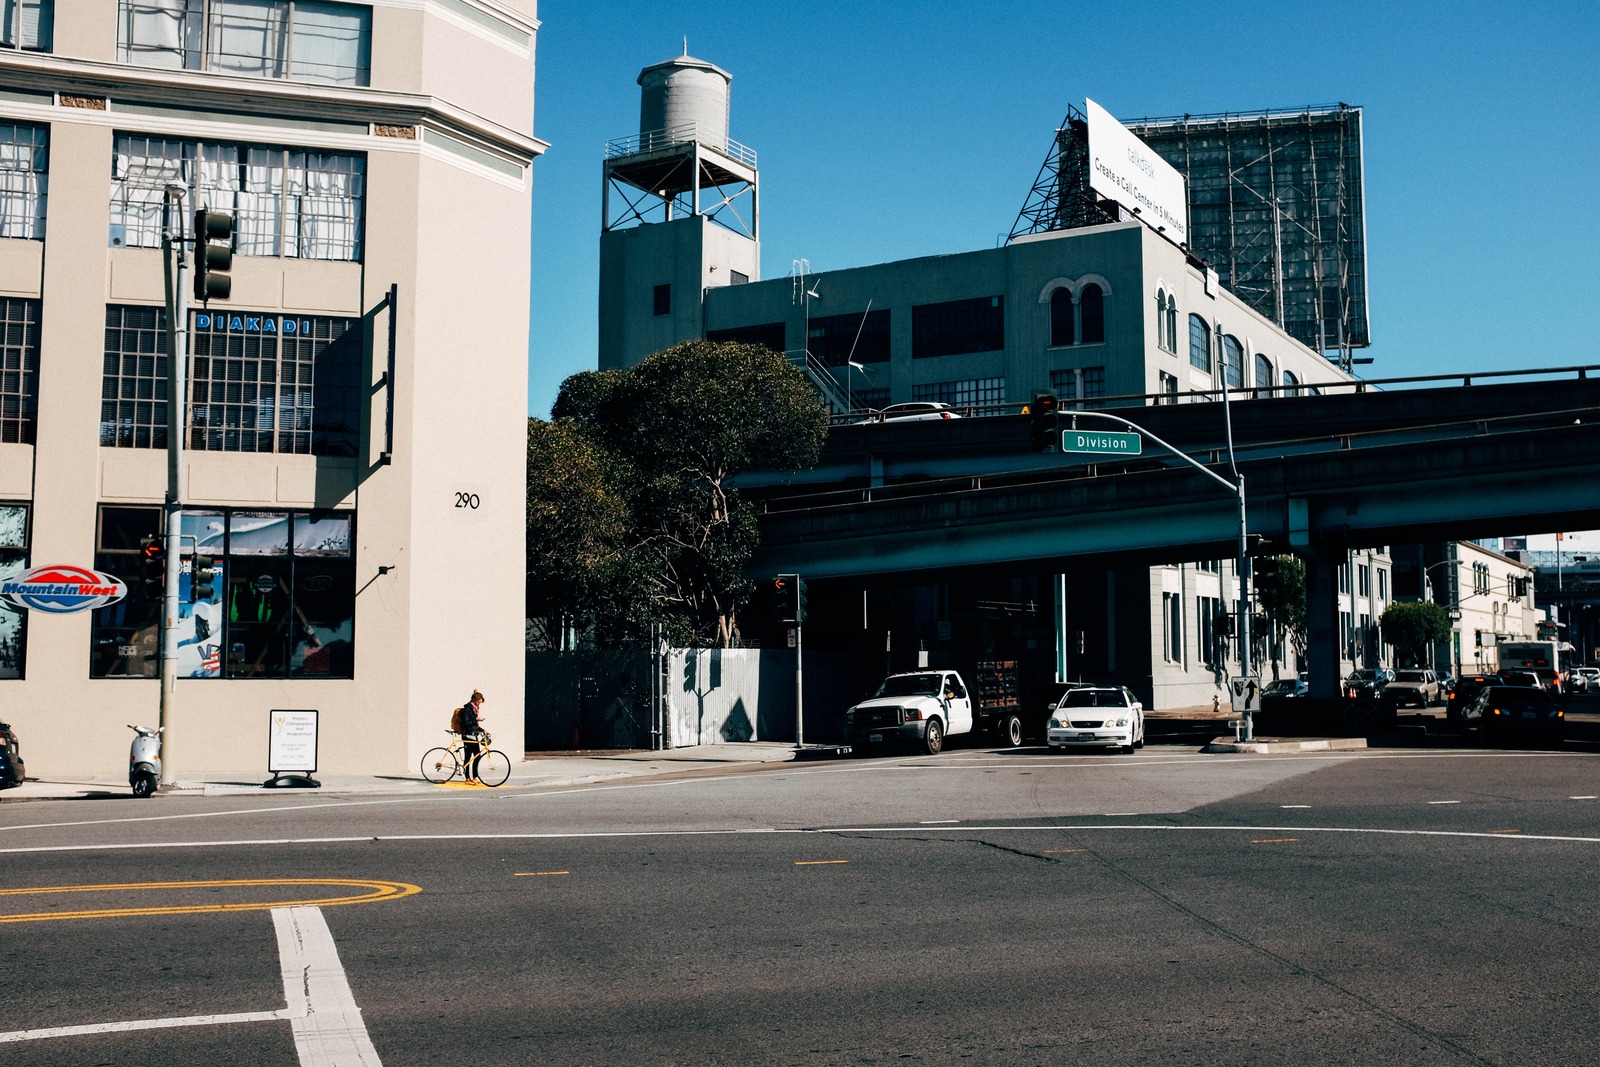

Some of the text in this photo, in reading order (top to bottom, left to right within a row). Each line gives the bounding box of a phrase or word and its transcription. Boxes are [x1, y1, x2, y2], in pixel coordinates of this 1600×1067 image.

[1127, 145, 1155, 180] talkdesk
[1095, 157, 1115, 183] Create
[1116, 173, 1120, 186] a
[1121, 177, 1133, 196] Call
[1133, 186, 1153, 209] Center
[1153, 200, 1159, 215] in
[1159, 205, 1163, 218] 5
[1163, 208, 1184, 234] Minutes
[196, 315, 310, 334] DIAKADI
[1077, 436, 1127, 449] Division
[454, 491, 480, 509] 290
[1, 582, 118, 596] MountainWest
